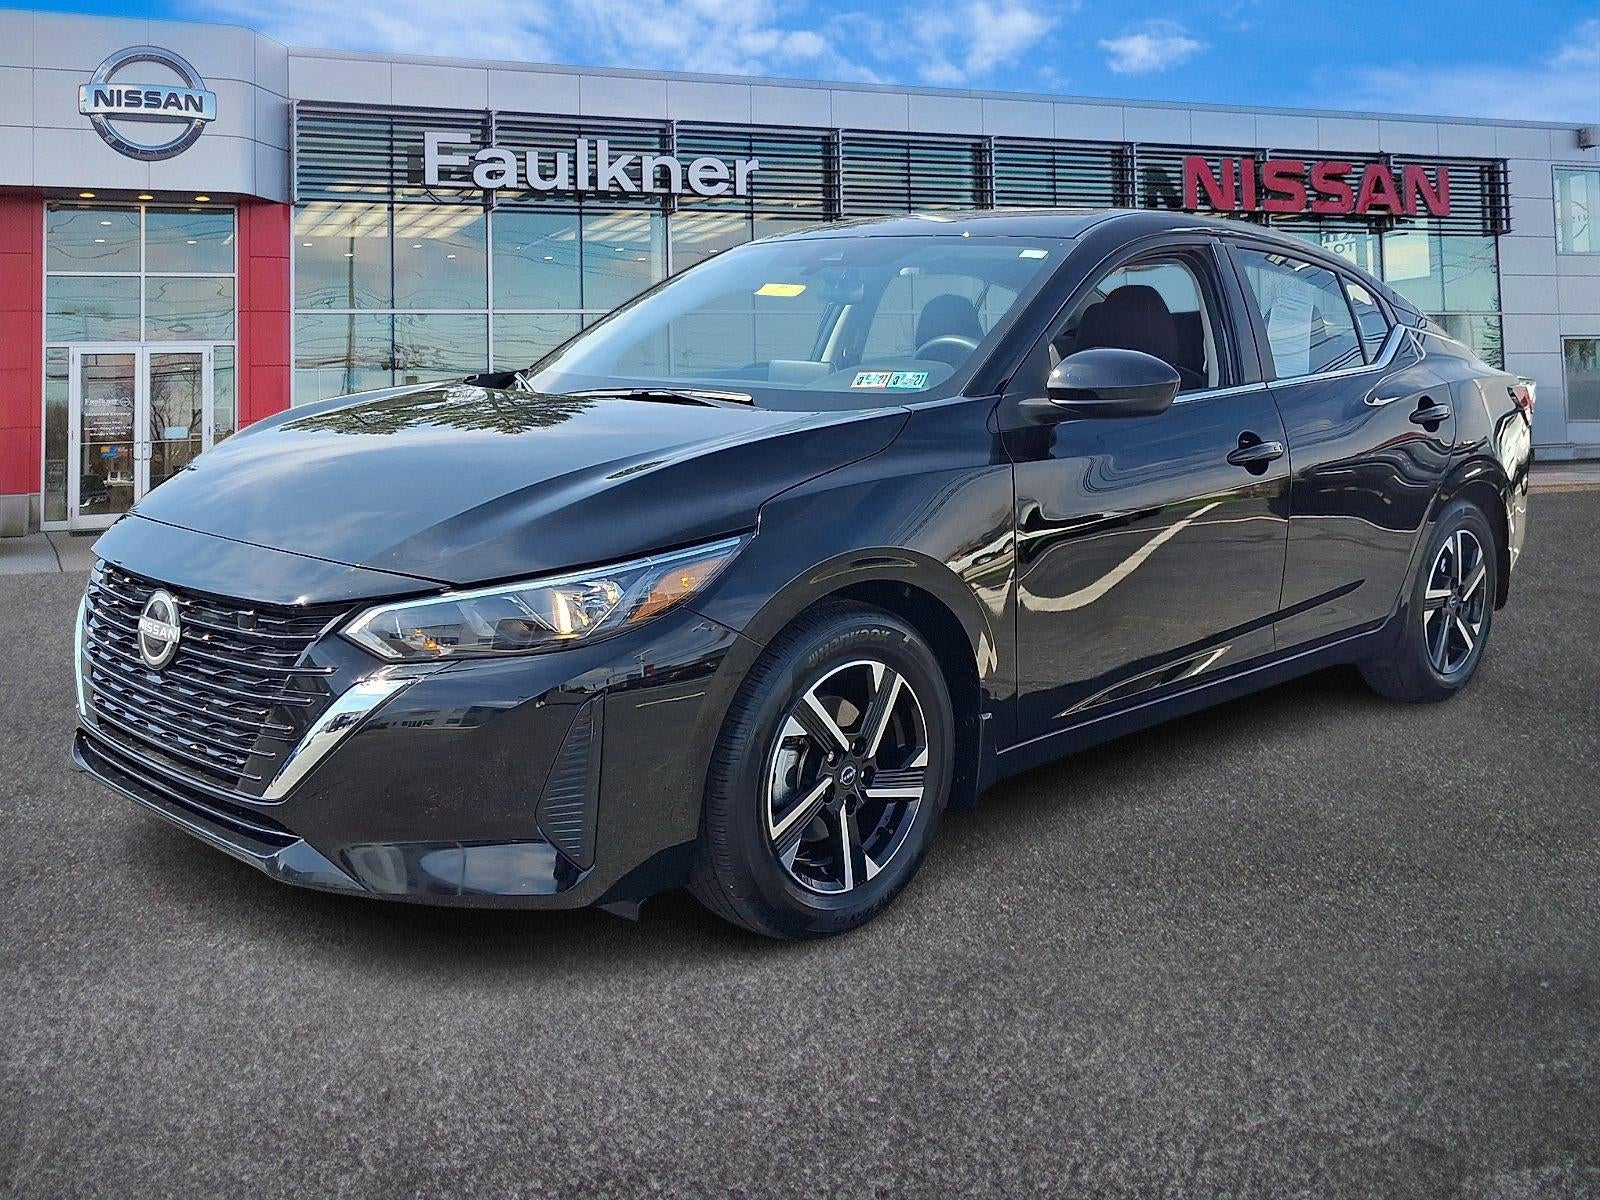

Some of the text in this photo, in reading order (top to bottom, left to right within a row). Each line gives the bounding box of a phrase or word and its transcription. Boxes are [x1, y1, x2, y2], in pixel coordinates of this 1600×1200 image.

[94, 89, 203, 113] NISSAN
[424, 132, 760, 196] Faulkner
[1183, 155, 1450, 216] NISSAN
[140, 617, 177, 641] NISSAN
